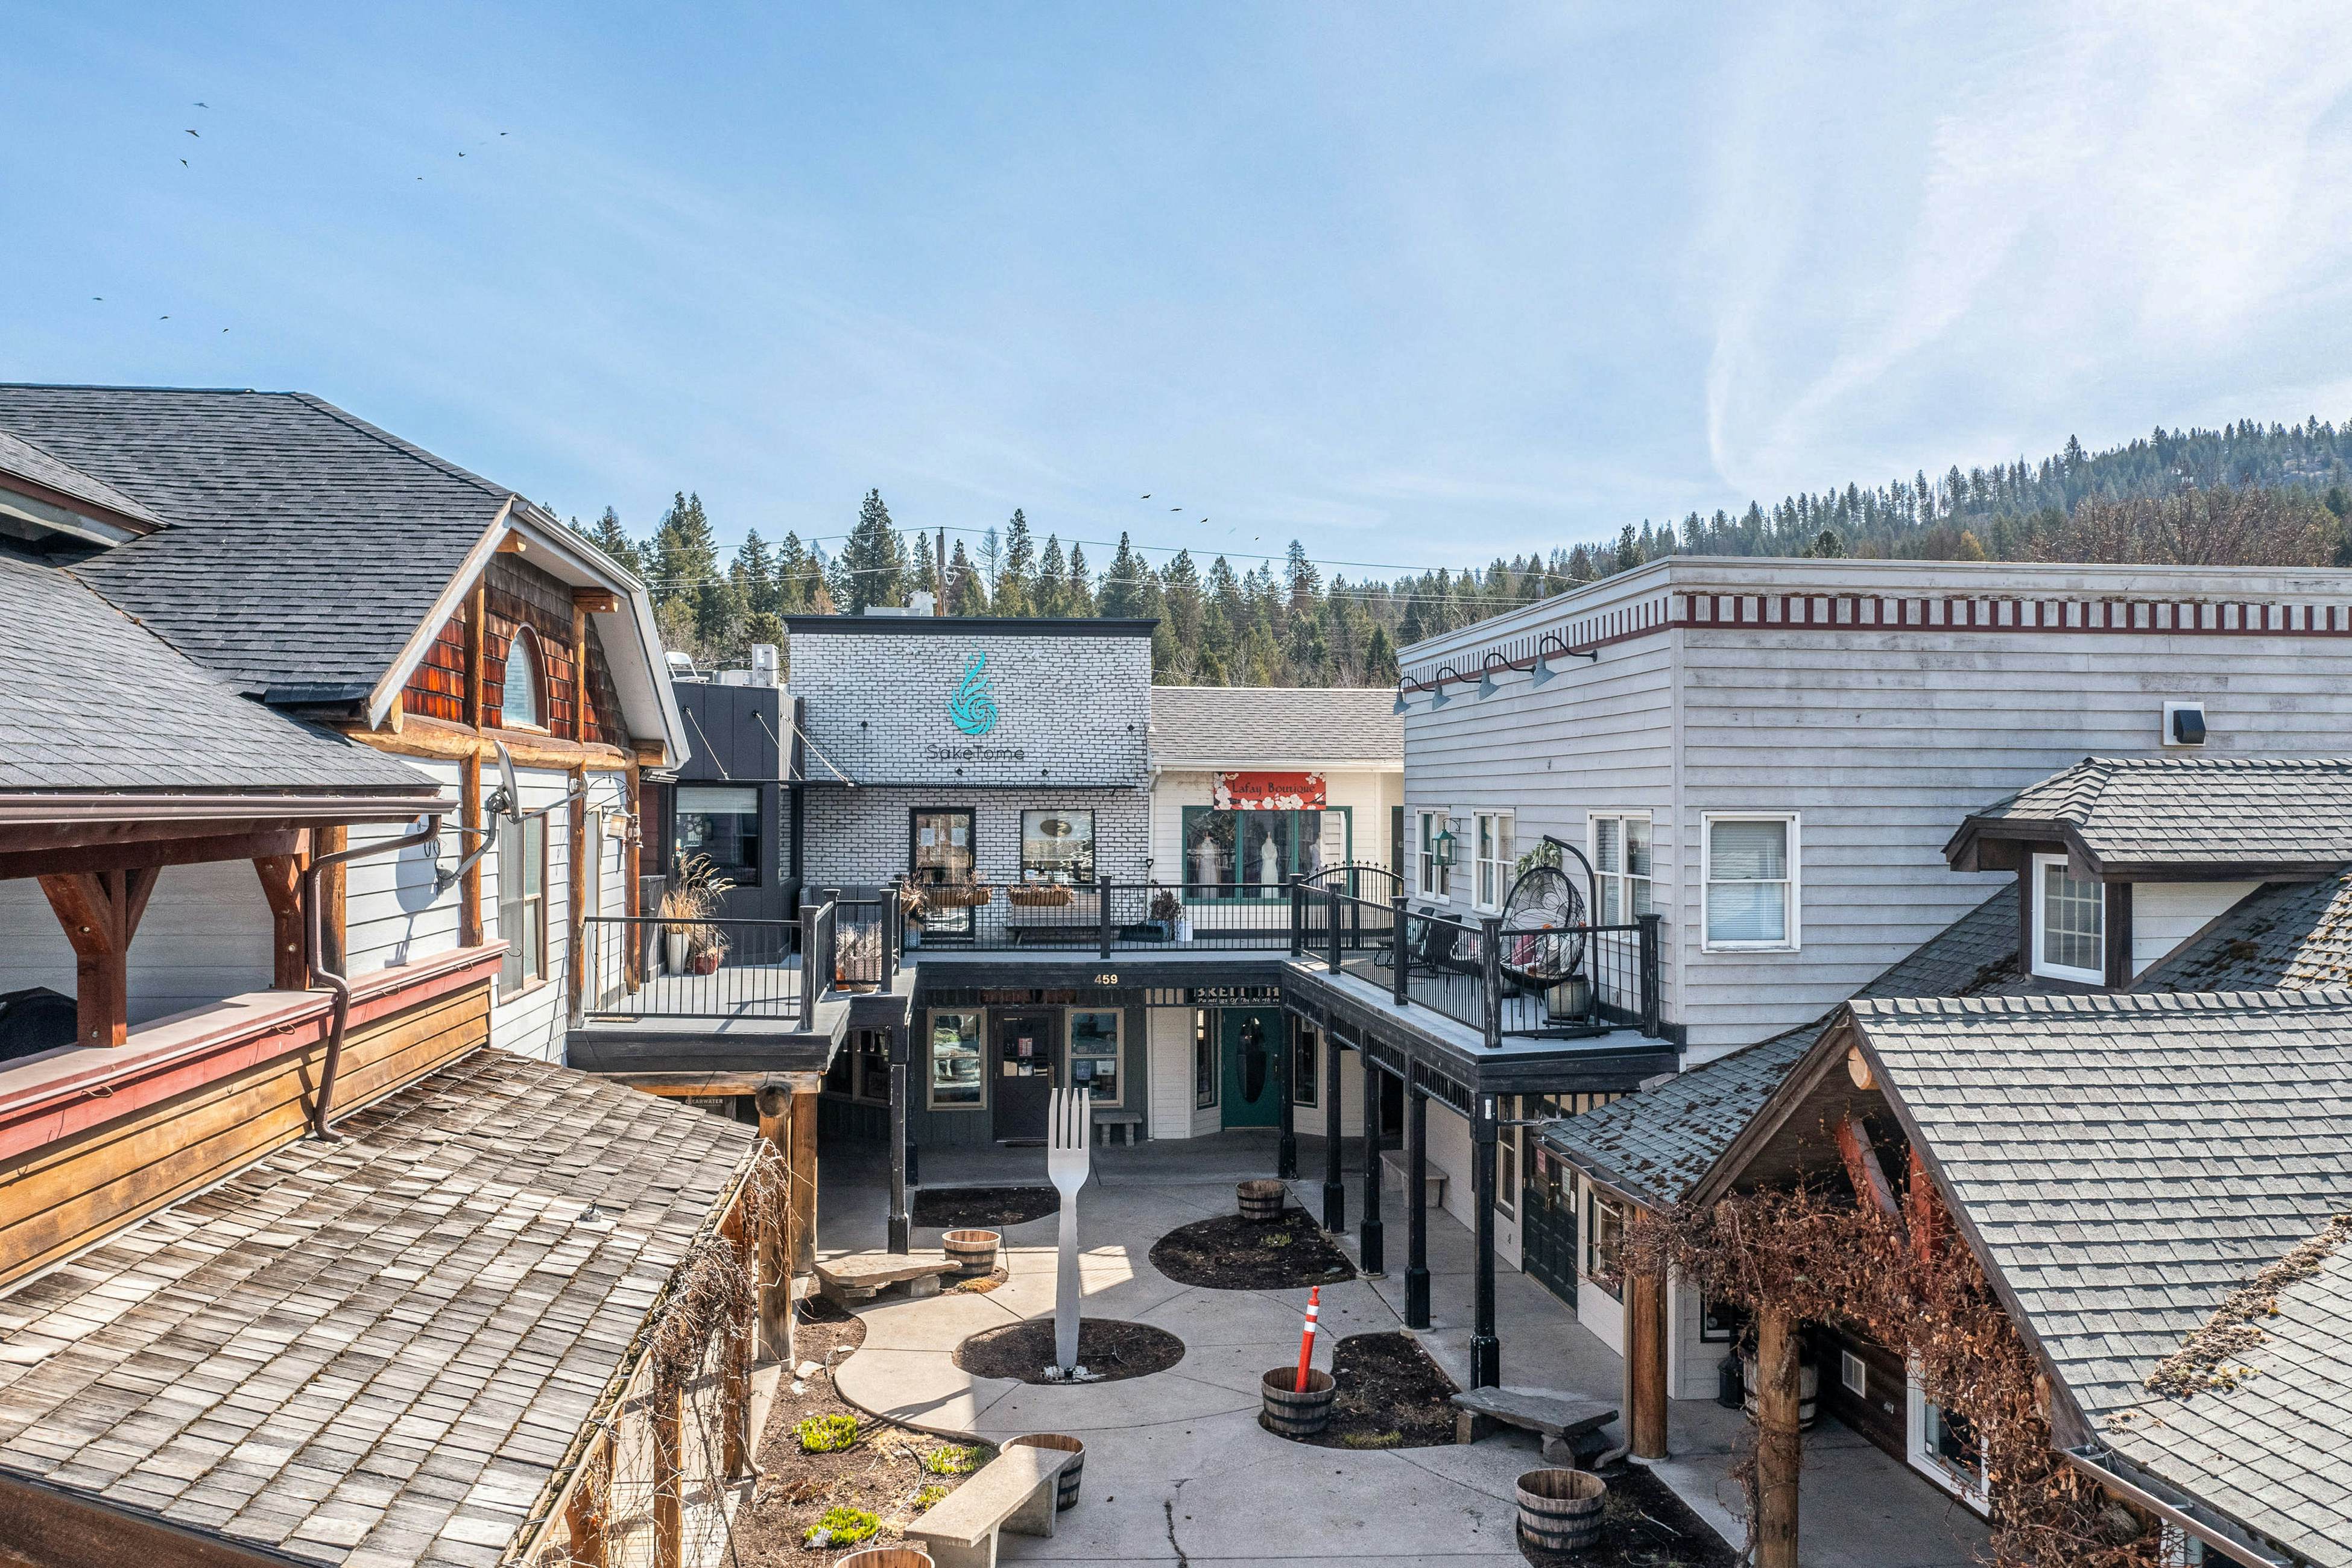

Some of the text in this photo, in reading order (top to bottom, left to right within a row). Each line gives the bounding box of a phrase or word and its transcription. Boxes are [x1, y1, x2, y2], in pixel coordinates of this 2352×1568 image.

[927, 744, 1025, 759] SakeTome
[1232, 782, 1315, 796] Lafay Boutique
[1094, 974, 1118, 984] 459
